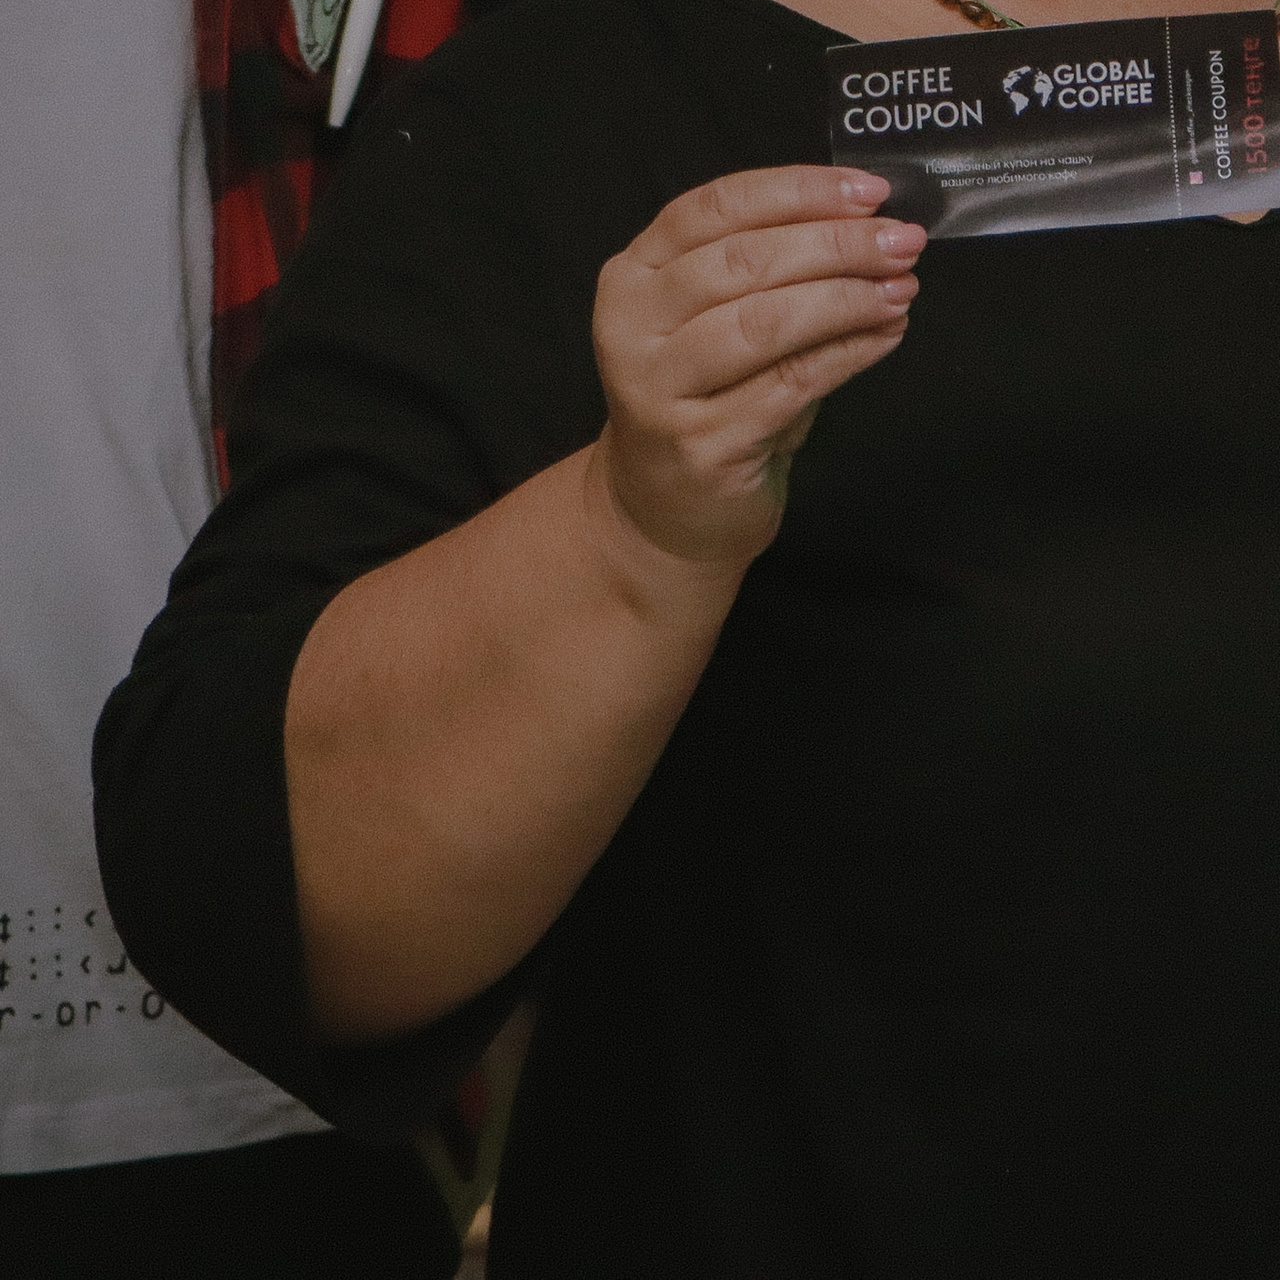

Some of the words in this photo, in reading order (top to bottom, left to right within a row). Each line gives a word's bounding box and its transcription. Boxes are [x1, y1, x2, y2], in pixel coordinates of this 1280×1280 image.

[842, 66, 953, 99] COFFEE
[1053, 58, 1155, 83] GLOBAL
[1209, 49, 1227, 120] COUPON
[1058, 83, 1152, 109] COFFEE
[843, 100, 983, 134] COUPON
[1214, 124, 1232, 180] COFFEE
[1243, 114, 1269, 174] 1500
[925, 159, 1001, 174] Подарочный
[1003, 159, 1037, 170] купон
[1040, 157, 1056, 166] на
[1057, 154, 1094, 166] чашку
[941, 177, 985, 188] вашего
[988, 172, 1047, 185] любимого
[1048, 168, 1079, 182] кофе
